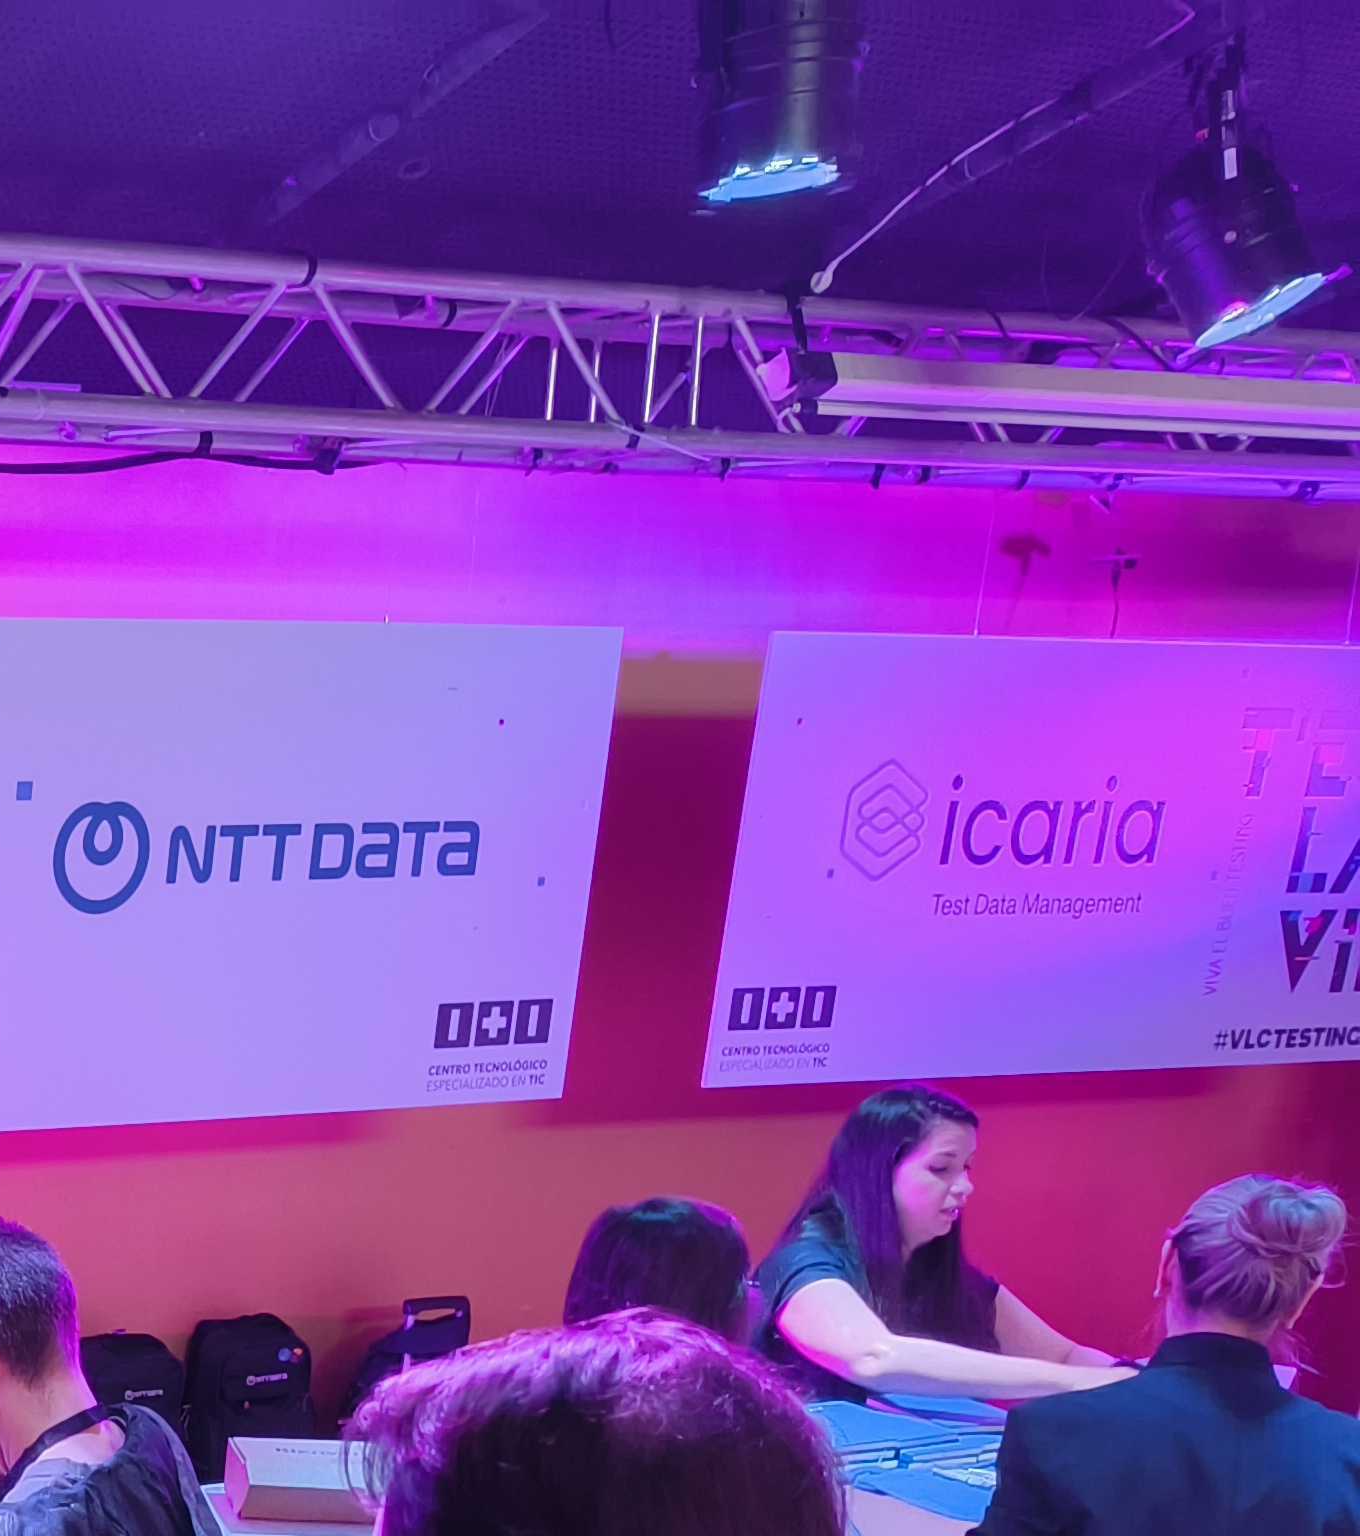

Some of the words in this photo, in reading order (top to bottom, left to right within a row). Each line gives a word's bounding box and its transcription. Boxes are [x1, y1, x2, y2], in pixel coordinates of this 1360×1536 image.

[939, 774, 1166, 866] icaria
[165, 824, 302, 884] NTT
[932, 893, 970, 916] Test
[974, 893, 1017, 916] Data
[1021, 893, 1142, 919] Management
[1203, 957, 1223, 997] VIVA
[722, 1045, 761, 1057] CENTRO
[428, 1063, 471, 1077] CENTRO
[474, 1059, 548, 1073] TECNOLÓGICO
[426, 1076, 509, 1093] ESPECIALIZADO
[512, 1075, 526, 1088] EN
[529, 1074, 546, 1086] TIC
